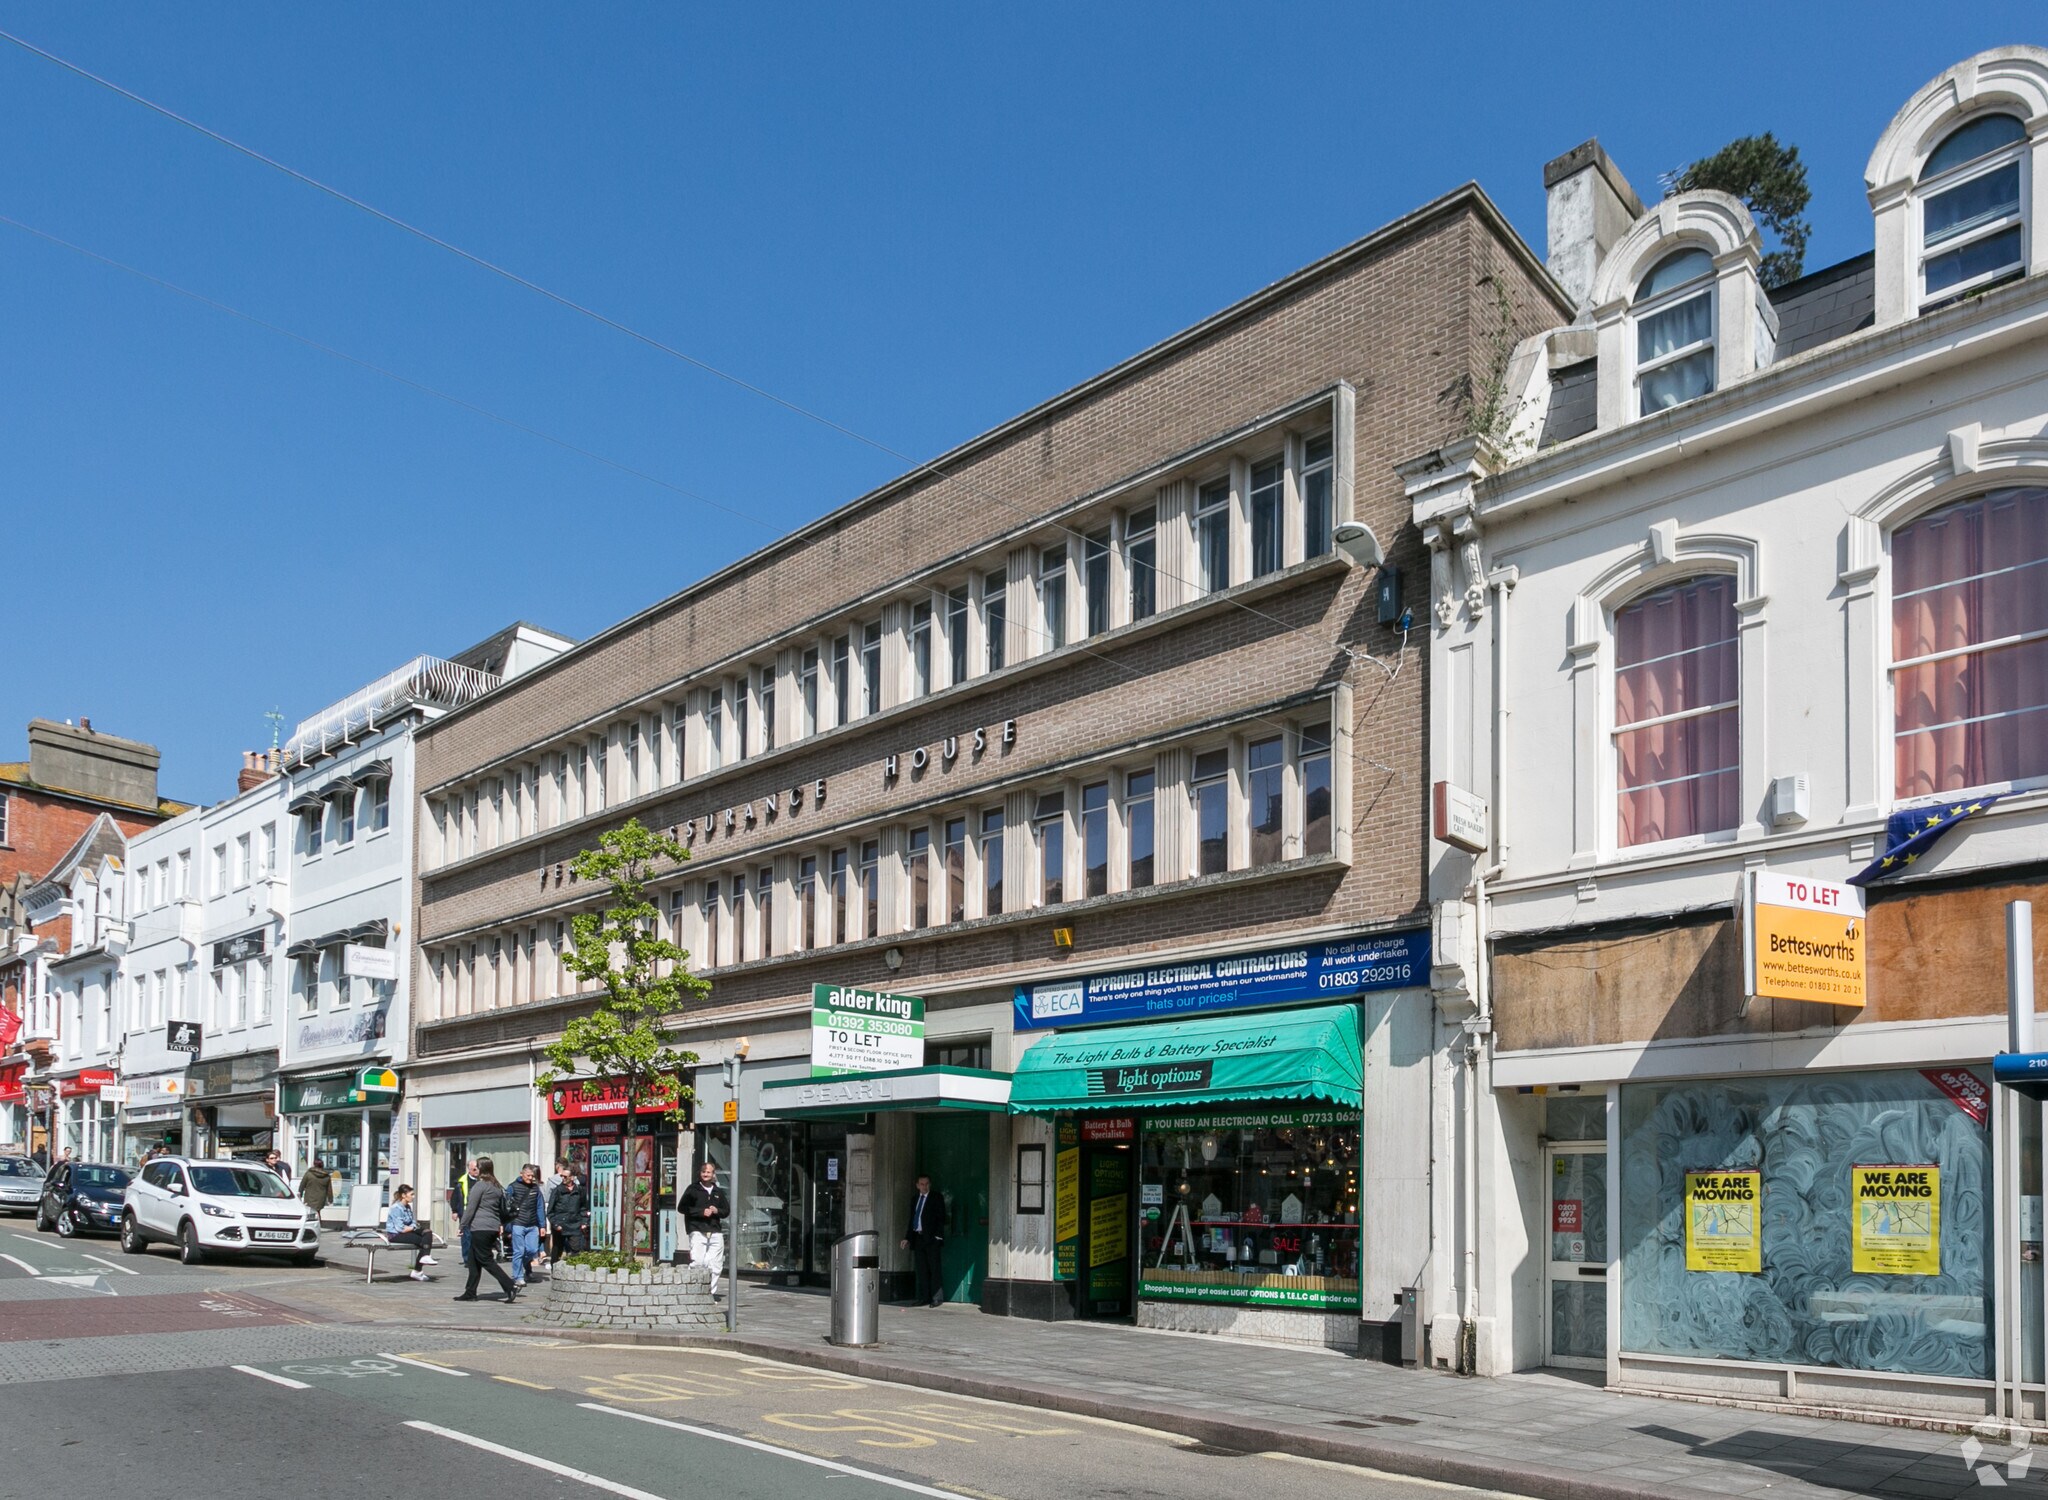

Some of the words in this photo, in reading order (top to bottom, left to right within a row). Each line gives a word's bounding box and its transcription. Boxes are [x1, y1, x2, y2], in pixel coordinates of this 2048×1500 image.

[655, 779, 827, 843] SSURANCE
[885, 719, 1015, 777] HOUSE
[1787, 882, 1807, 901] TO
[1813, 886, 1839, 906] LET
[1325, 947, 1338, 956] No
[1339, 944, 1355, 954] call
[1357, 942, 1372, 951] out
[1373, 938, 1405, 949] charge
[1770, 933, 1855, 961] Bettesworths
[1322, 957, 1333, 967] All
[1334, 954, 1356, 965] work
[1358, 948, 1409, 962] undertaken
[1089, 973, 1145, 994] APPROVED
[1147, 963, 1213, 986] ELECTRICAL
[1216, 951, 1307, 978] CONTRACTORS
[1319, 970, 1358, 988] 01803
[1361, 964, 1411, 983] 292916
[1763, 961, 1861, 980] www.bettesworths.co.uk
[1089, 994, 1114, 1003] There's
[1114, 993, 1129, 1001] only
[1144, 987, 1162, 996] thing
[1163, 985, 1182, 995] you'll
[1183, 983, 1198, 991] love
[1200, 981, 1219, 989] more
[1254, 970, 1307, 983] workmanship
[1764, 976, 1807, 990] Telephone:
[1809, 981, 1831, 991] 01803
[1833, 983, 1841, 992] 21
[1843, 984, 1852, 994] 20
[1854, 985, 1862, 994] 21
[829, 987, 874, 1011] alder
[875, 992, 911, 1020] king
[1051, 993, 1080, 1012] ECA
[1146, 1000, 1174, 1011] thats
[1176, 996, 1195, 1007] our
[1198, 989, 1238, 1007] prices!
[828, 1014, 865, 1030] 01392
[867, 1019, 913, 1036] 353080
[168, 1044, 200, 1052] TATTOO
[829, 1030, 848, 1043] TO
[855, 1033, 882, 1047] LET
[1052, 1053, 1073, 1065] The
[1075, 1051, 1107, 1065] Light
[1111, 1048, 1140, 1061] Bulb
[1144, 1046, 1155, 1058] &
[1157, 1043, 1209, 1058] Battery
[1211, 1035, 1277, 1052] Specialist
[1117, 1069, 1148, 1093] light
[1151, 1067, 1203, 1090] options
[1957, 1073, 1986, 1096] 0203
[800, 1080, 891, 1104] PEARL
[1940, 1072, 1962, 1089] 697
[1960, 1087, 1988, 1110] 9929
[1084, 1120, 1108, 1130] Battery
[1116, 1119, 1132, 1128] Bulb
[1146, 1120, 1153, 1129] IF
[1154, 1119, 1172, 1128] YOU
[1174, 1118, 1196, 1128] NEED
[1197, 1118, 1210, 1127] AN
[1212, 1115, 1268, 1127] ELECTRICIAN
[1271, 1114, 1294, 1124] CALL
[1302, 1112, 1333, 1123] 07733
[1090, 1129, 1125, 1140] Specialists
[1695, 1178, 1718, 1188] WE
[1722, 1177, 1750, 1188] ARE
[1864, 1172, 1891, 1184] WE
[1894, 1172, 1928, 1184] ARE
[1693, 1189, 1754, 1200] MOVING
[1860, 1185, 1932, 1197] MOVING
[1273, 1237, 1300, 1251] SALE
[1144, 1284, 1173, 1295] Shopping
[1173, 1285, 1184, 1293] has
[1185, 1286, 1197, 1295] just
[1198, 1287, 1209, 1296] got
[1210, 1288, 1229, 1296] easier
[1230, 1289, 1248, 1297] LIGHT
[1250, 1289, 1278, 1299] OPTIONS
[1280, 1291, 1285, 1299] &
[1310, 1294, 1319, 1302] all
[1320, 1294, 1341, 1303] under
